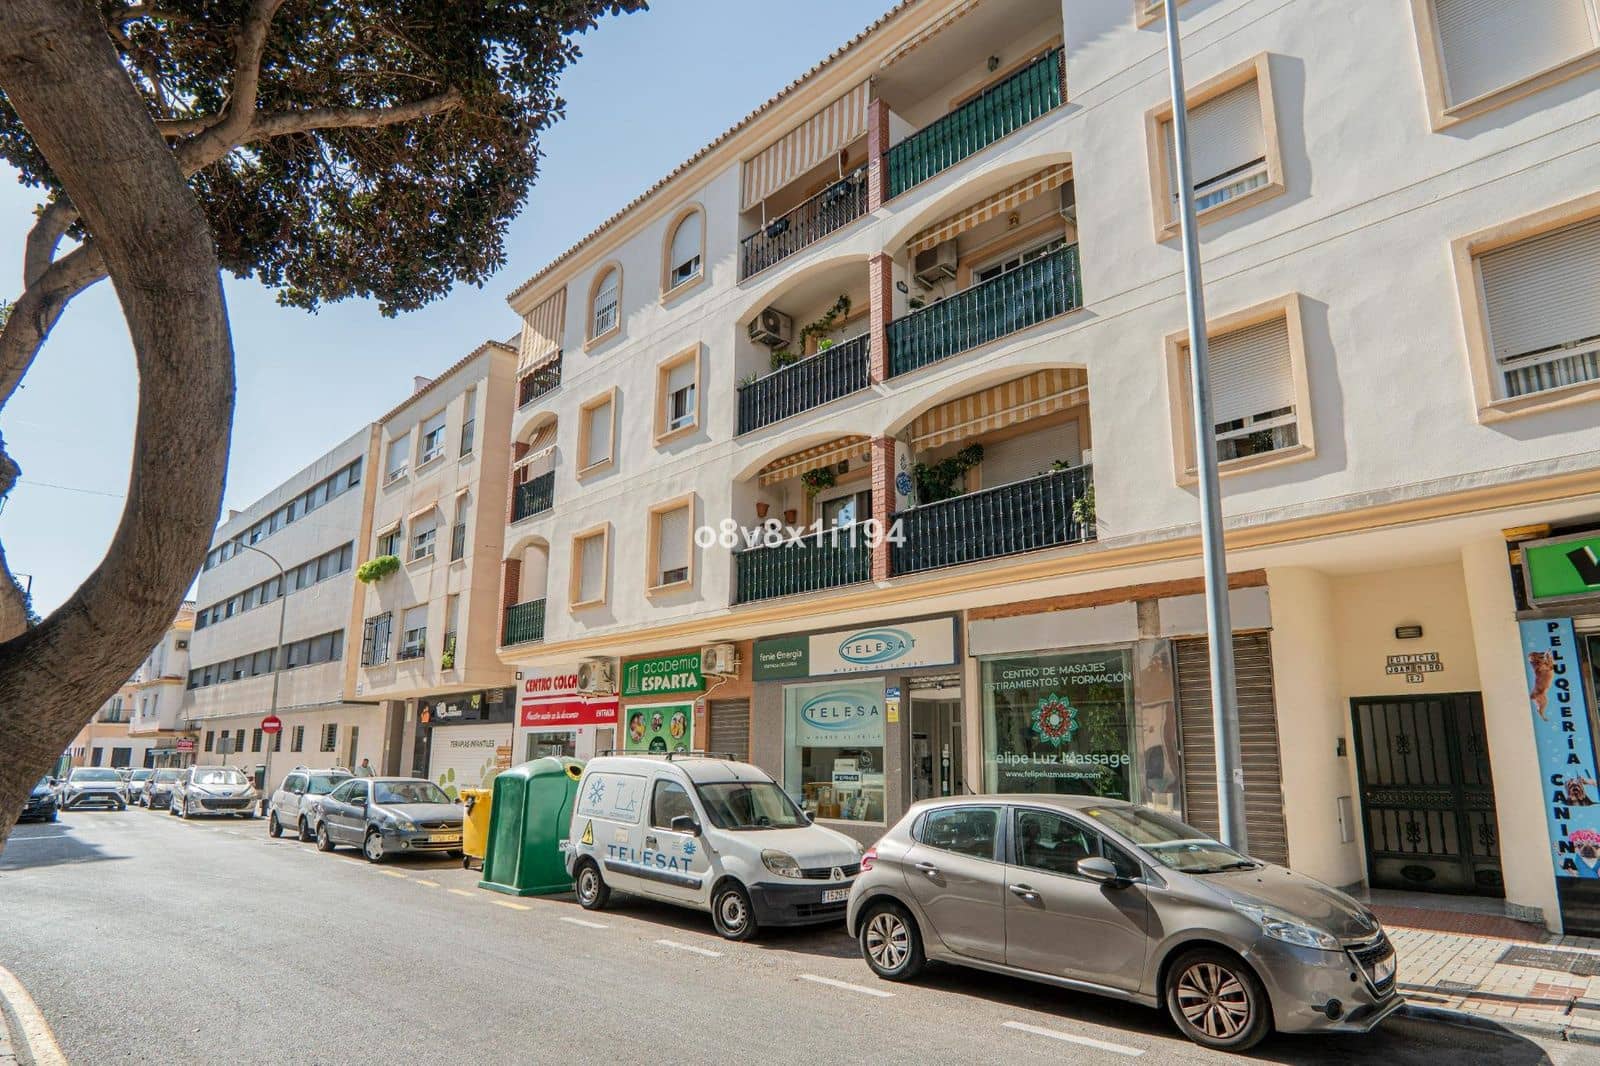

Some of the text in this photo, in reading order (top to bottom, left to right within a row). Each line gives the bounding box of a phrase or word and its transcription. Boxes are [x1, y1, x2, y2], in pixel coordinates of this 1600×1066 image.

[845, 639, 917, 655] TELESAT
[1002, 662, 1106, 680] CENTRO DE MASAJES
[525, 677, 552, 692] CENTRO
[641, 672, 698, 691] ESPARTA
[984, 671, 1132, 691] ESTIRAMIENTOS Y FORMACIÓN
[1547, 622, 1581, 765] PELUQUERÍA
[808, 705, 879, 718] TELESA
[991, 750, 1130, 768] elipe Luz Massage
[1005, 769, 1101, 780] www.felipeluzmassage.com
[1549, 773, 1579, 870] CANINA
[607, 844, 693, 873] TELESAT
